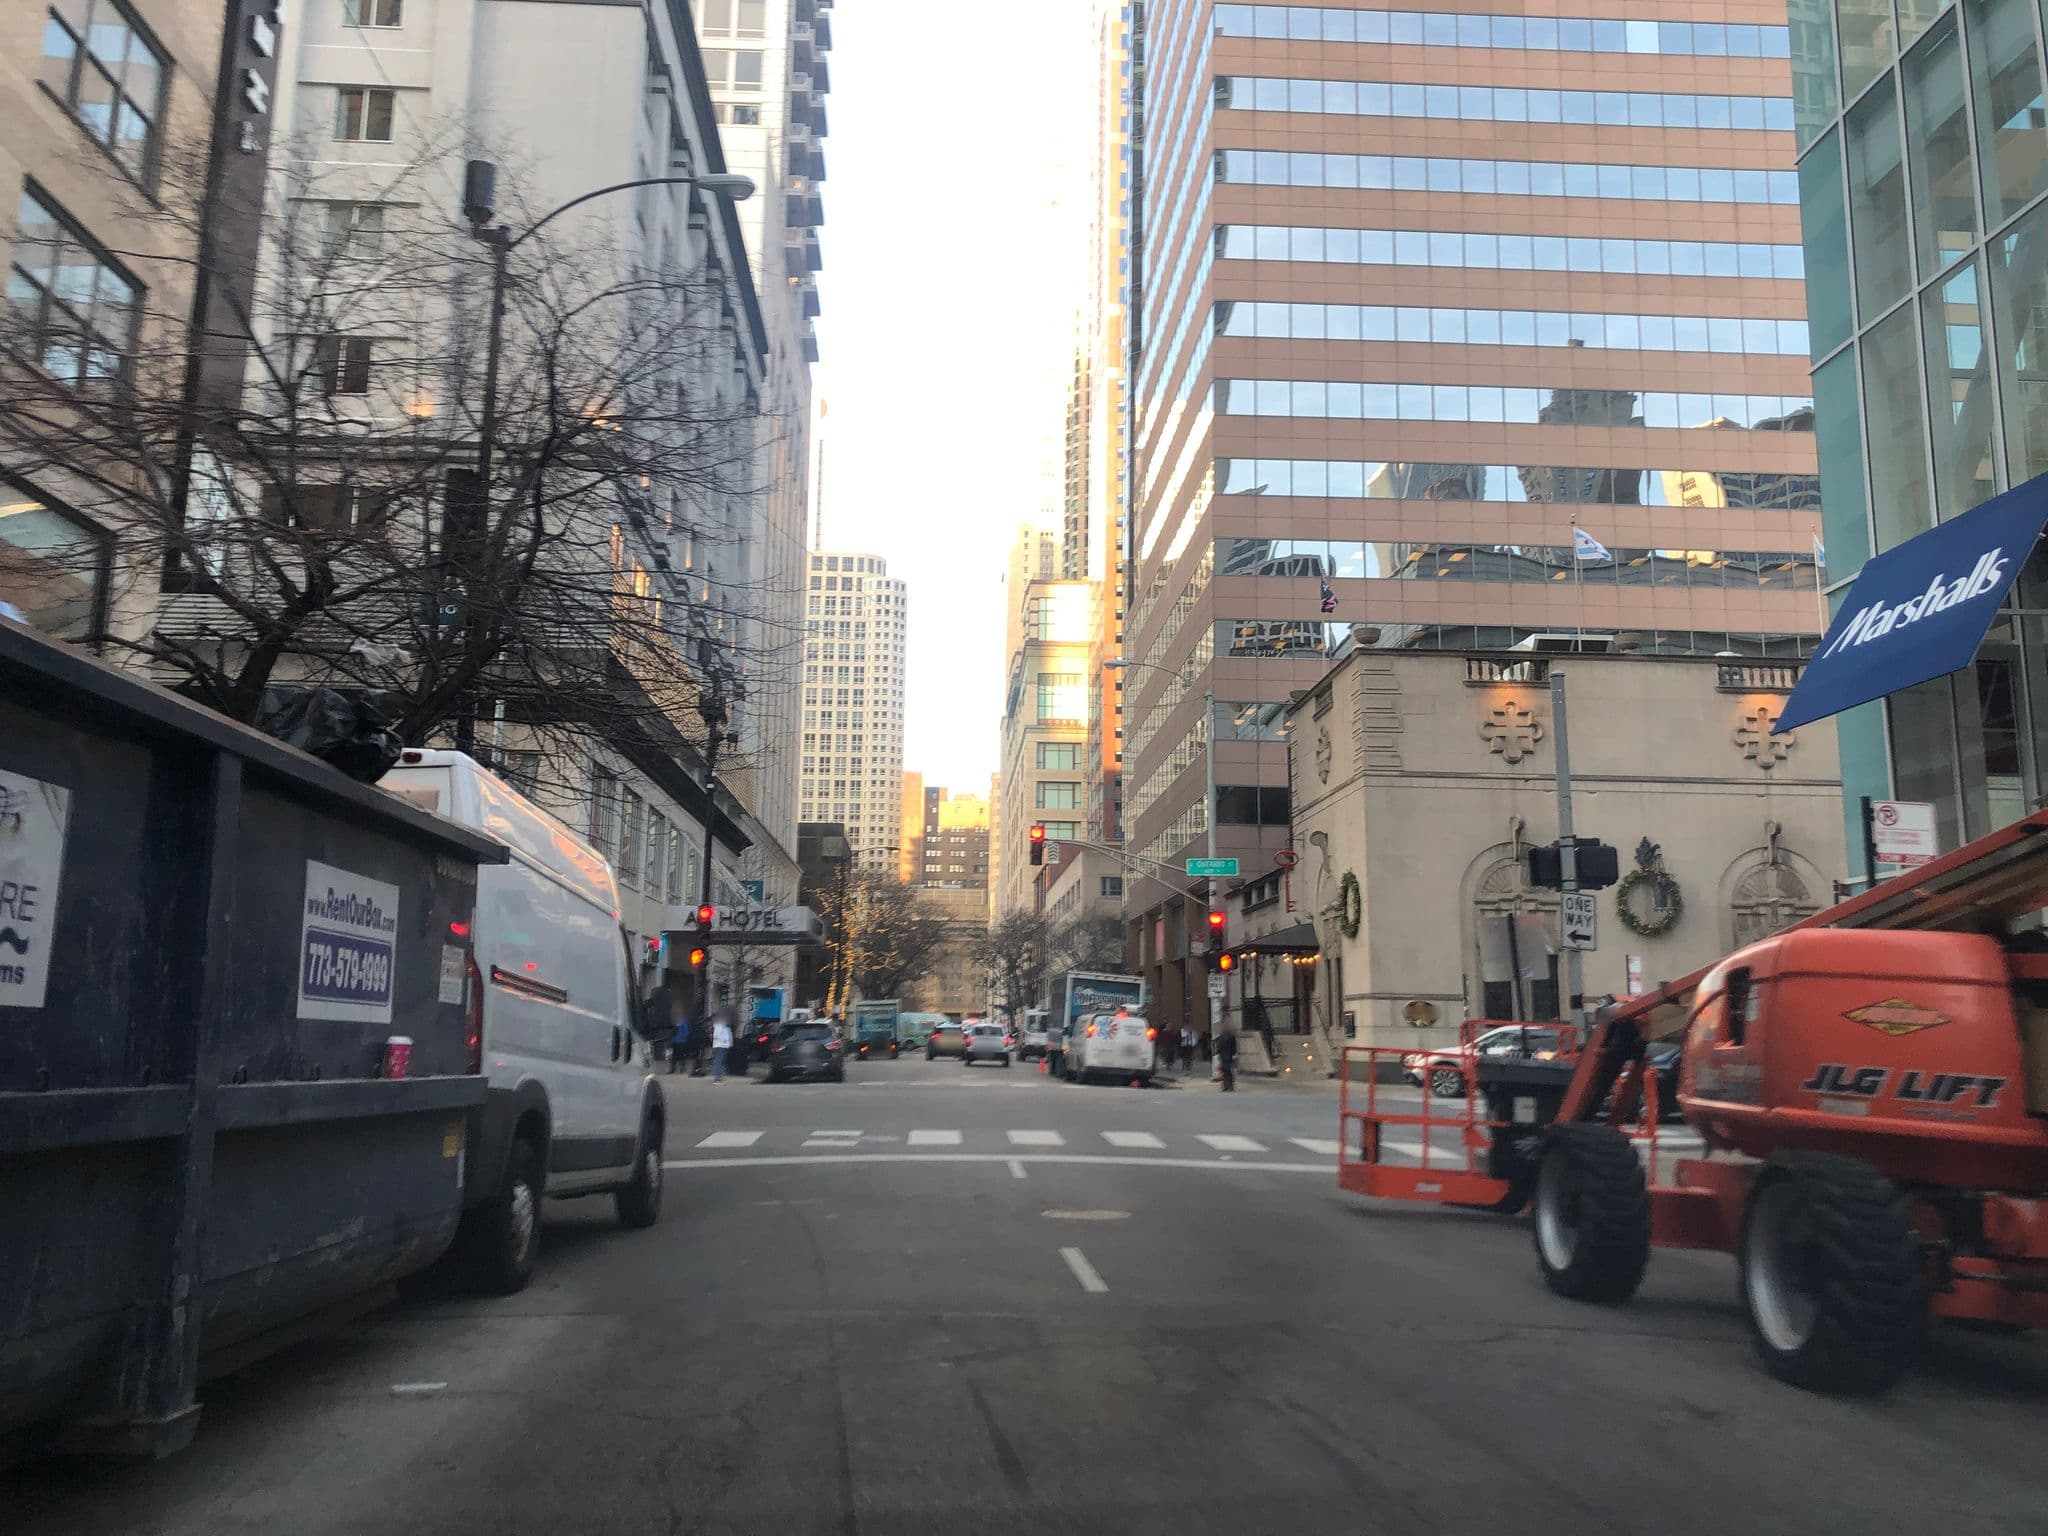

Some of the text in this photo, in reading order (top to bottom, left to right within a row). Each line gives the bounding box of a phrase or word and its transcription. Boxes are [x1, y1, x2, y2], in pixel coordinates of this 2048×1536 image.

[1822, 547, 2009, 660] Marshalls
[719, 909, 783, 928] HOTEL
[1565, 897, 1592, 913] ONE
[1565, 912, 1592, 928] WAY
[309, 942, 389, 993] 773-579-1999
[1801, 1063, 2008, 1108] JLG LIFT
